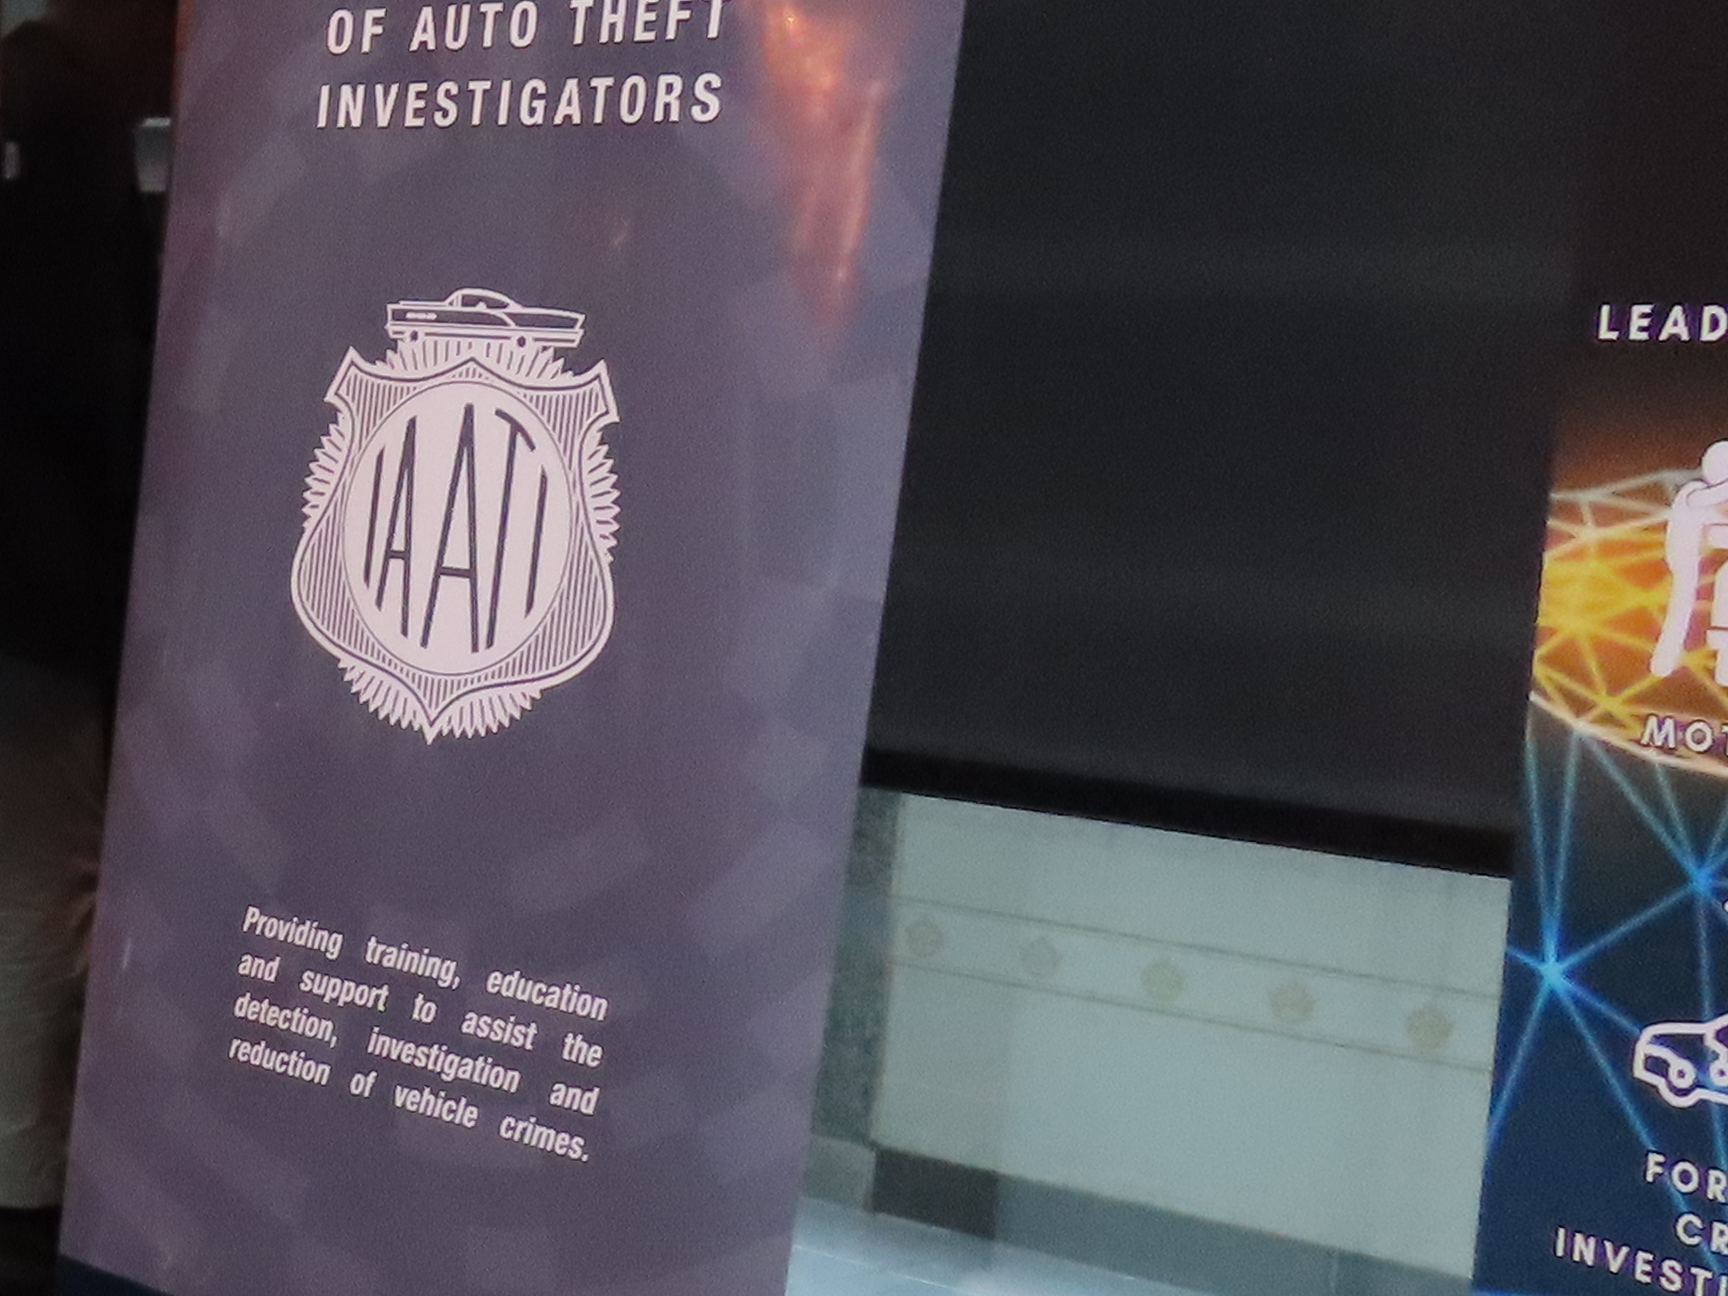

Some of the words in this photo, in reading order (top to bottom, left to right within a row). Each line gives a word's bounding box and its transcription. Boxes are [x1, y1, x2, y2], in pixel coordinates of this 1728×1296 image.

[326, 7, 386, 54] OF
[410, 0, 538, 53] AUTO
[317, 72, 723, 130] INVESTIGATORS
[363, 402, 548, 653] IAATI
[238, 951, 280, 984] and
[300, 968, 389, 1013] support
[413, 993, 437, 1024] to
[462, 1007, 537, 1051] assist
[563, 1032, 603, 1069] the
[243, 905, 343, 960] Providing
[365, 935, 461, 991] training,
[486, 966, 609, 1021] education
[229, 1035, 332, 1086] reduction
[350, 1068, 376, 1099] of
[394, 1083, 479, 1129] vehicle
[499, 1111, 589, 1163] crimes.
[235, 993, 339, 1048] detection,
[367, 1026, 521, 1094] investigation
[550, 1080, 601, 1116] and
